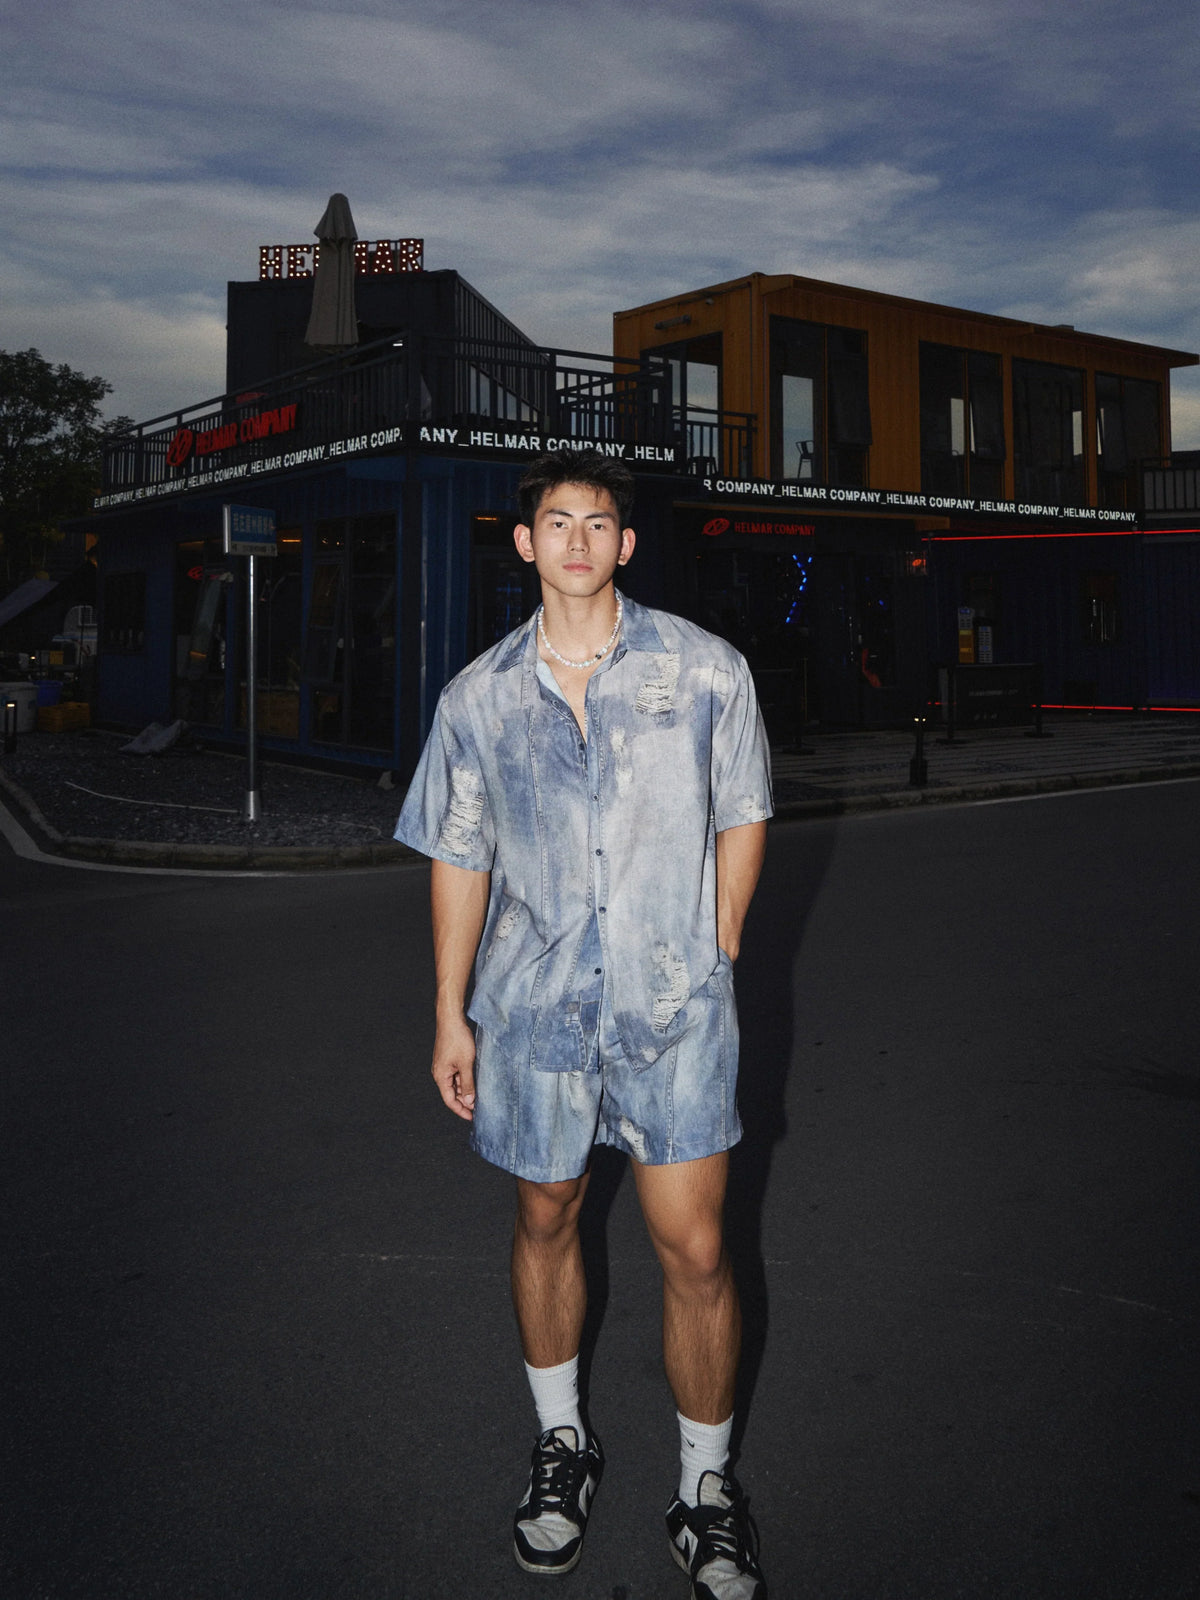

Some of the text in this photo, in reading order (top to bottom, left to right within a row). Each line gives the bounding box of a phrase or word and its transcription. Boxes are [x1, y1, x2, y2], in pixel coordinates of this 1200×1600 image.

[196, 403, 298, 455] HELMAR COMPANY
[370, 426, 403, 448] COMP
[734, 521, 815, 536] HELMAR COMPANY
